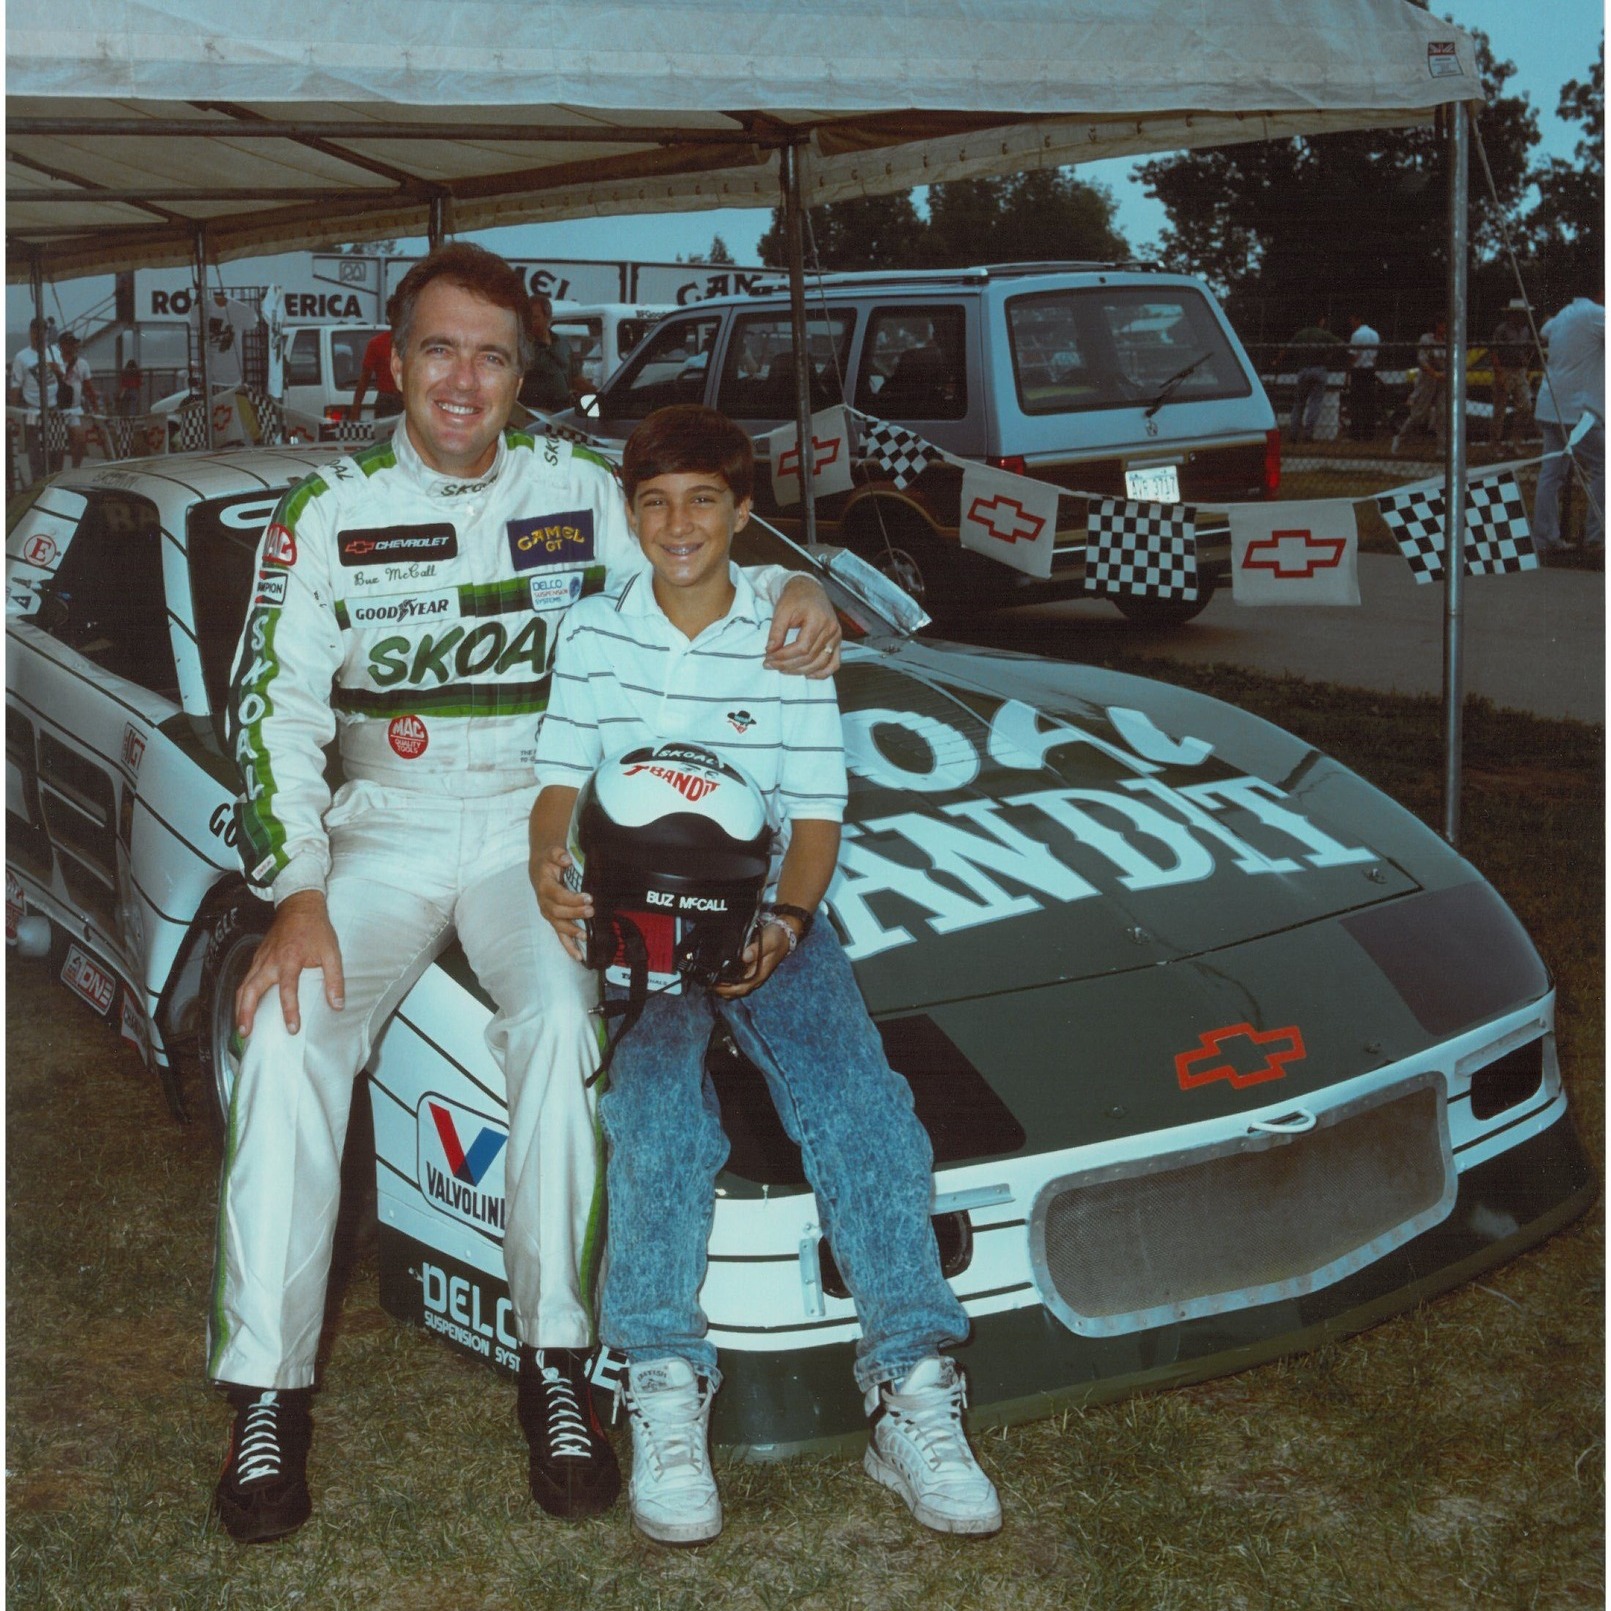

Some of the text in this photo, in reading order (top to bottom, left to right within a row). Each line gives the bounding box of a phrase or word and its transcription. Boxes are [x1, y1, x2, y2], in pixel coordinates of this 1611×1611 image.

[677, 273, 763, 305] CAM
[152, 290, 363, 318] RO ERICA
[29, 537, 52, 562] E
[375, 537, 449, 550] CHEVROLET
[517, 525, 585, 551] CAMEL
[545, 540, 562, 552] GT
[385, 563, 437, 581] McCall
[533, 579, 562, 591] DELCO
[236, 614, 273, 800] SKOAL
[392, 717, 425, 738] MAC
[395, 739, 421, 749] QUALITY
[841, 698, 1214, 792] OAL
[658, 749, 715, 765] SKOAL
[827, 776, 1381, 961] ANDIT
[646, 890, 673, 907] BUZ
[423, 1261, 522, 1350] DELC
[424, 1310, 520, 1373] SUSPENSION SYST
